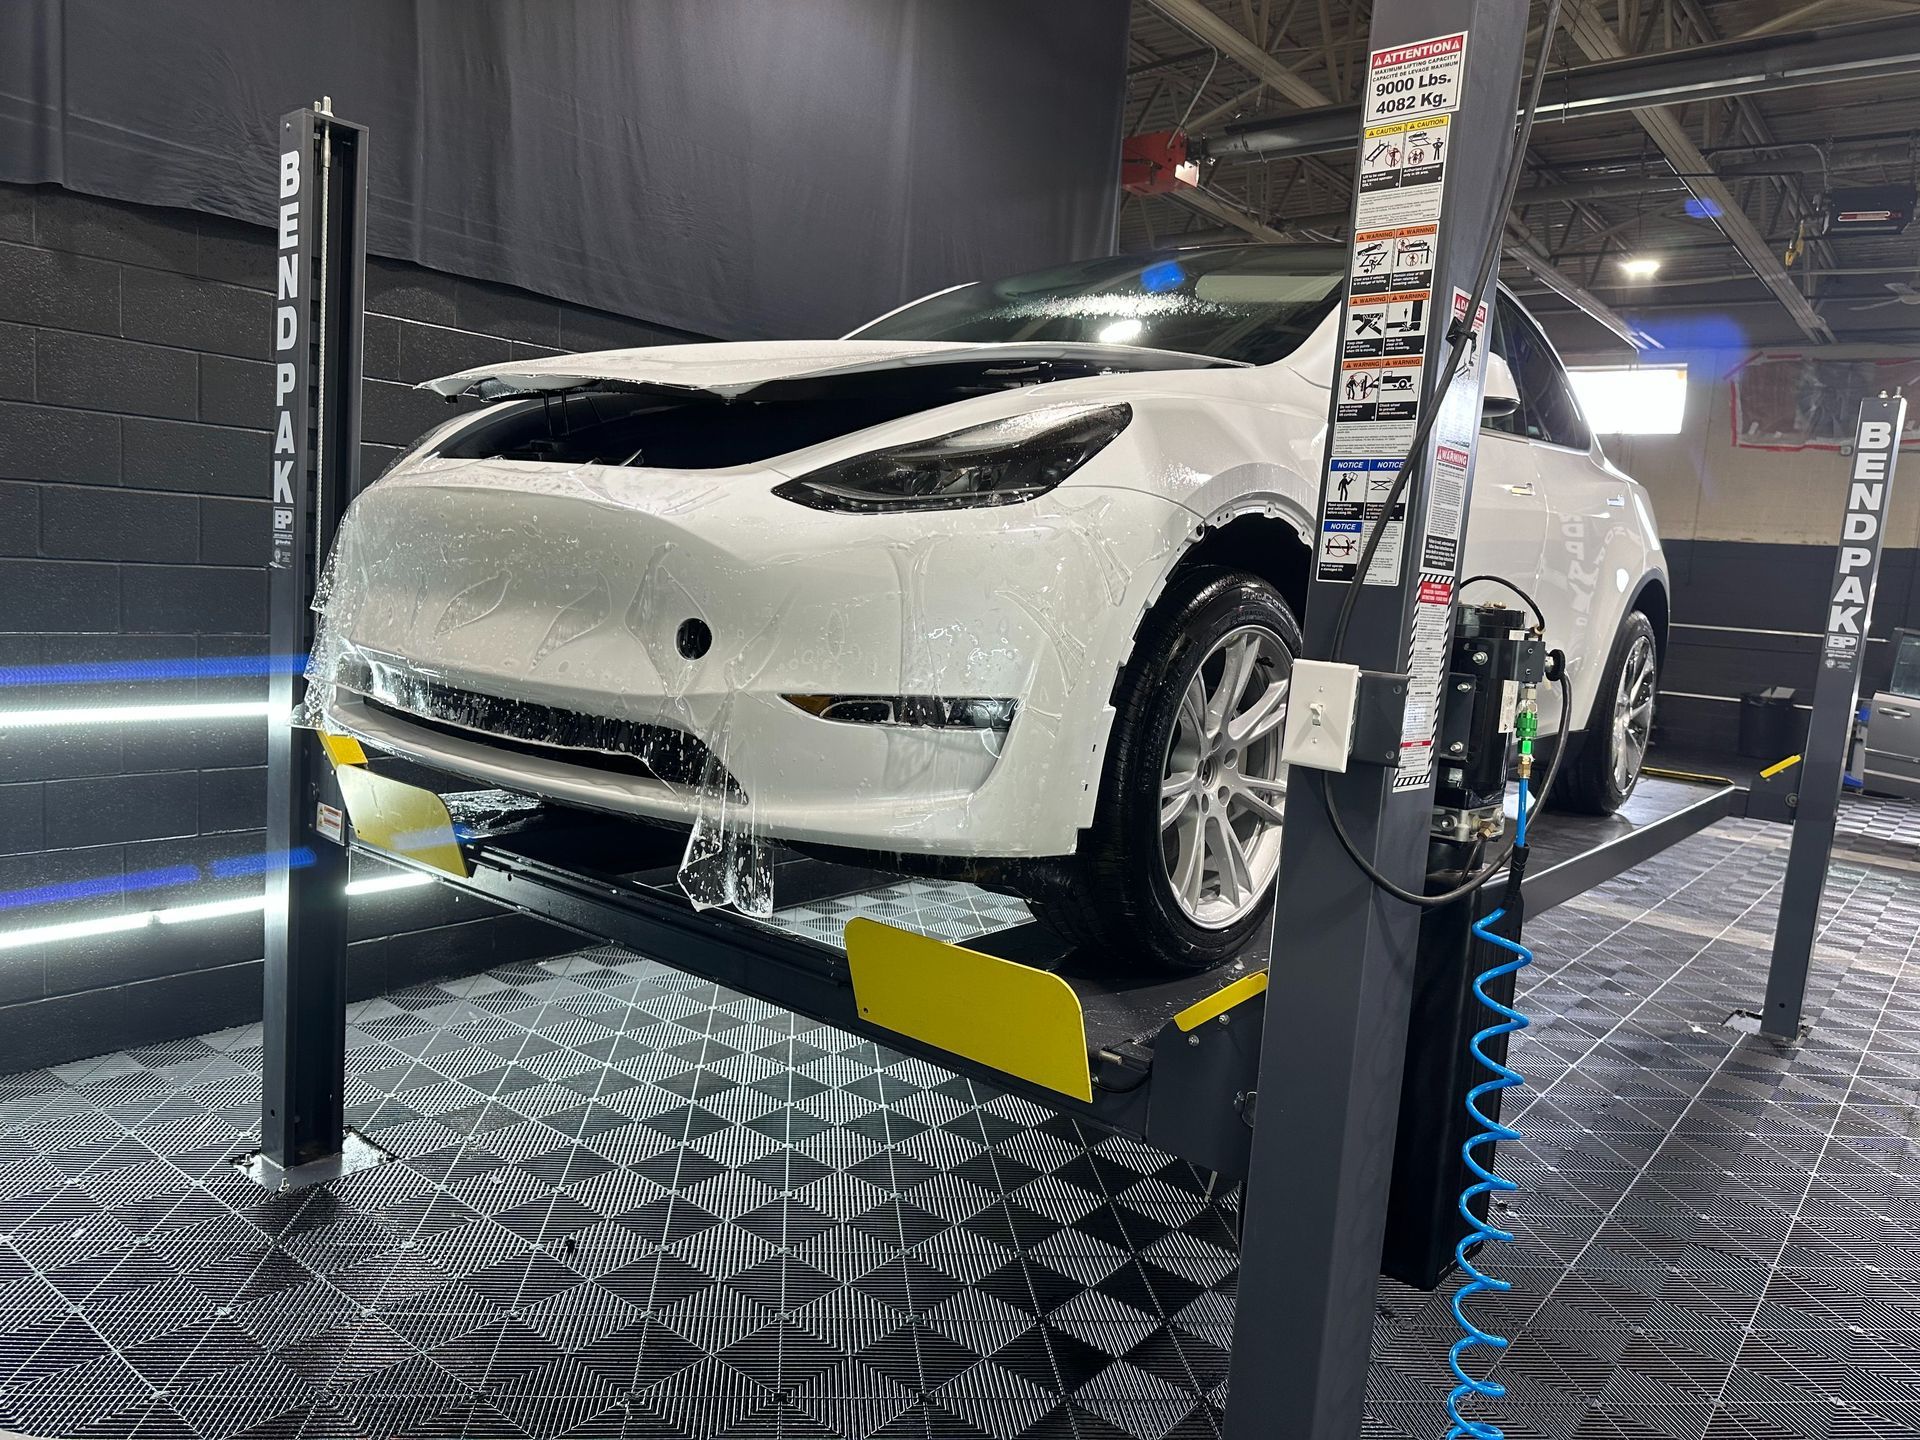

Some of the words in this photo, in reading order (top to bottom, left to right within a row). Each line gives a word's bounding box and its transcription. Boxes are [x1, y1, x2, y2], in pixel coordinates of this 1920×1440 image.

[1383, 40, 1452, 64] ATTENTION
[1374, 66, 1402, 75] MAXIMUM
[1404, 60, 1426, 70] LIFTING
[1428, 54, 1458, 65] CAPACITY
[1408, 67, 1430, 75] LEVAGE
[1430, 60, 1458, 71] MAXIMUM
[1376, 78, 1414, 96] 9000
[1418, 73, 1452, 88] Lbs.
[1376, 96, 1416, 114] 4082
[1420, 92, 1447, 108] Kg.
[1376, 126, 1402, 135] CAUTION
[1417, 119, 1444, 128] CAUTION
[273, 150, 300, 504] BENDPAK
[1442, 450, 1467, 465] WARNING
[275, 510, 292, 529] BP
[1828, 422, 1891, 634] BENDPAK
[1828, 636, 1856, 648] BP
